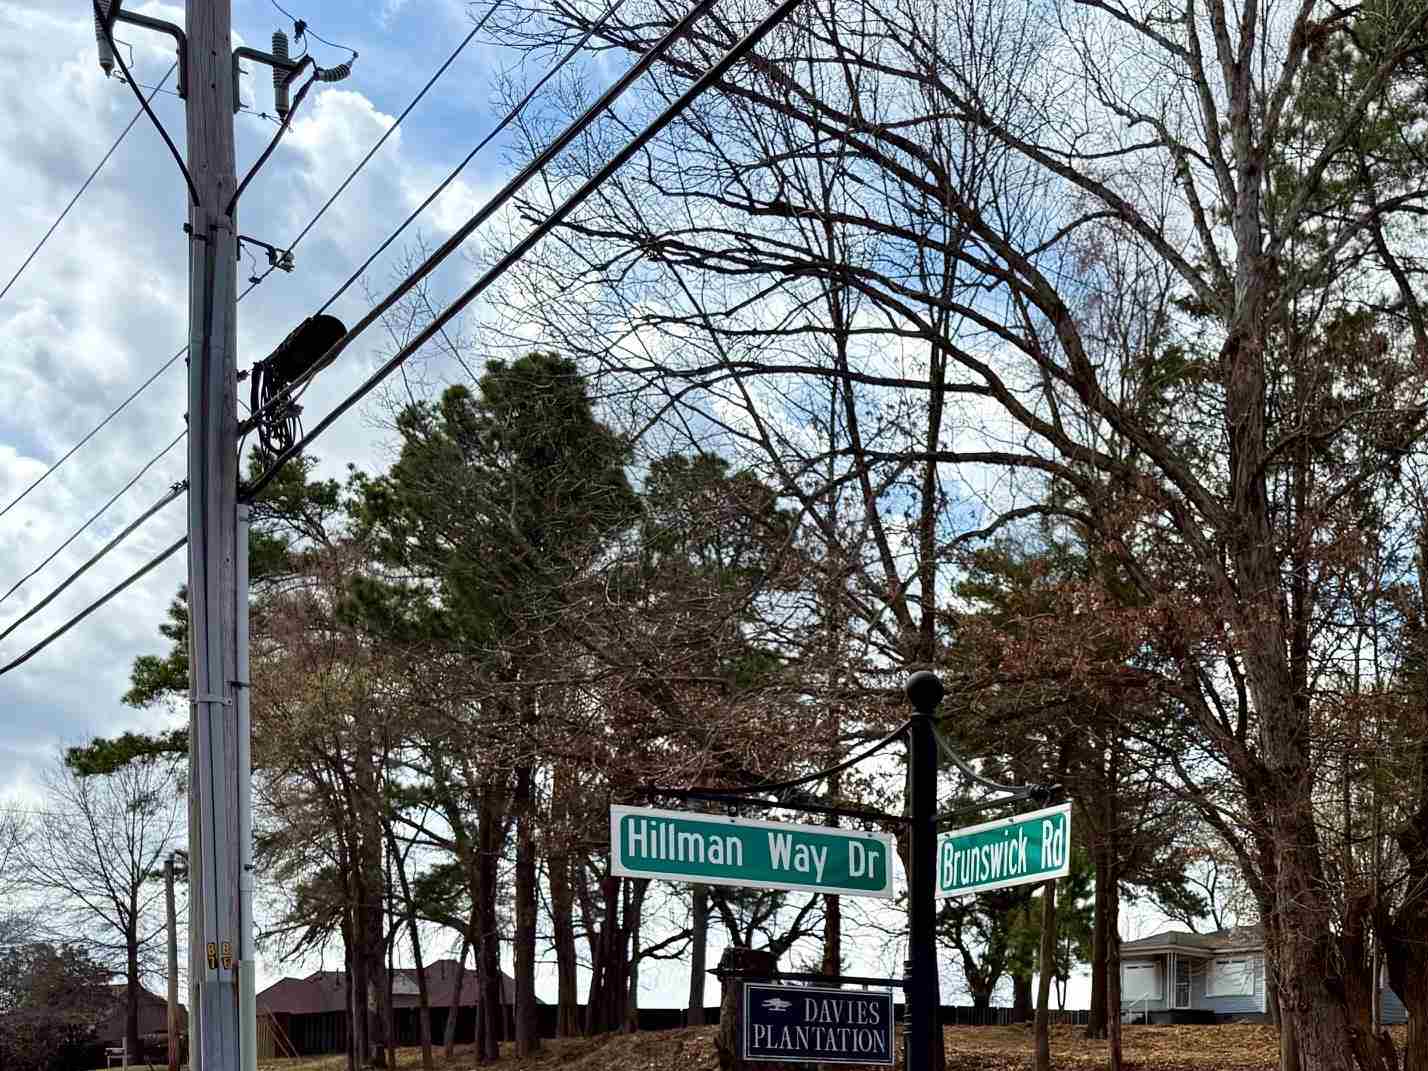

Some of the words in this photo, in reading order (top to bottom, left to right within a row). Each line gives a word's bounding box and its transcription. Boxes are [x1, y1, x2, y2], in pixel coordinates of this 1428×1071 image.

[627, 817, 743, 867] Hillman
[767, 831, 828, 883] Way
[848, 840, 880, 879] Dr
[942, 825, 1028, 889] Brunswick
[1040, 817, 1064, 870] Rd
[803, 998, 880, 1025] DAVIES
[751, 1023, 886, 1053] PLANTATION
